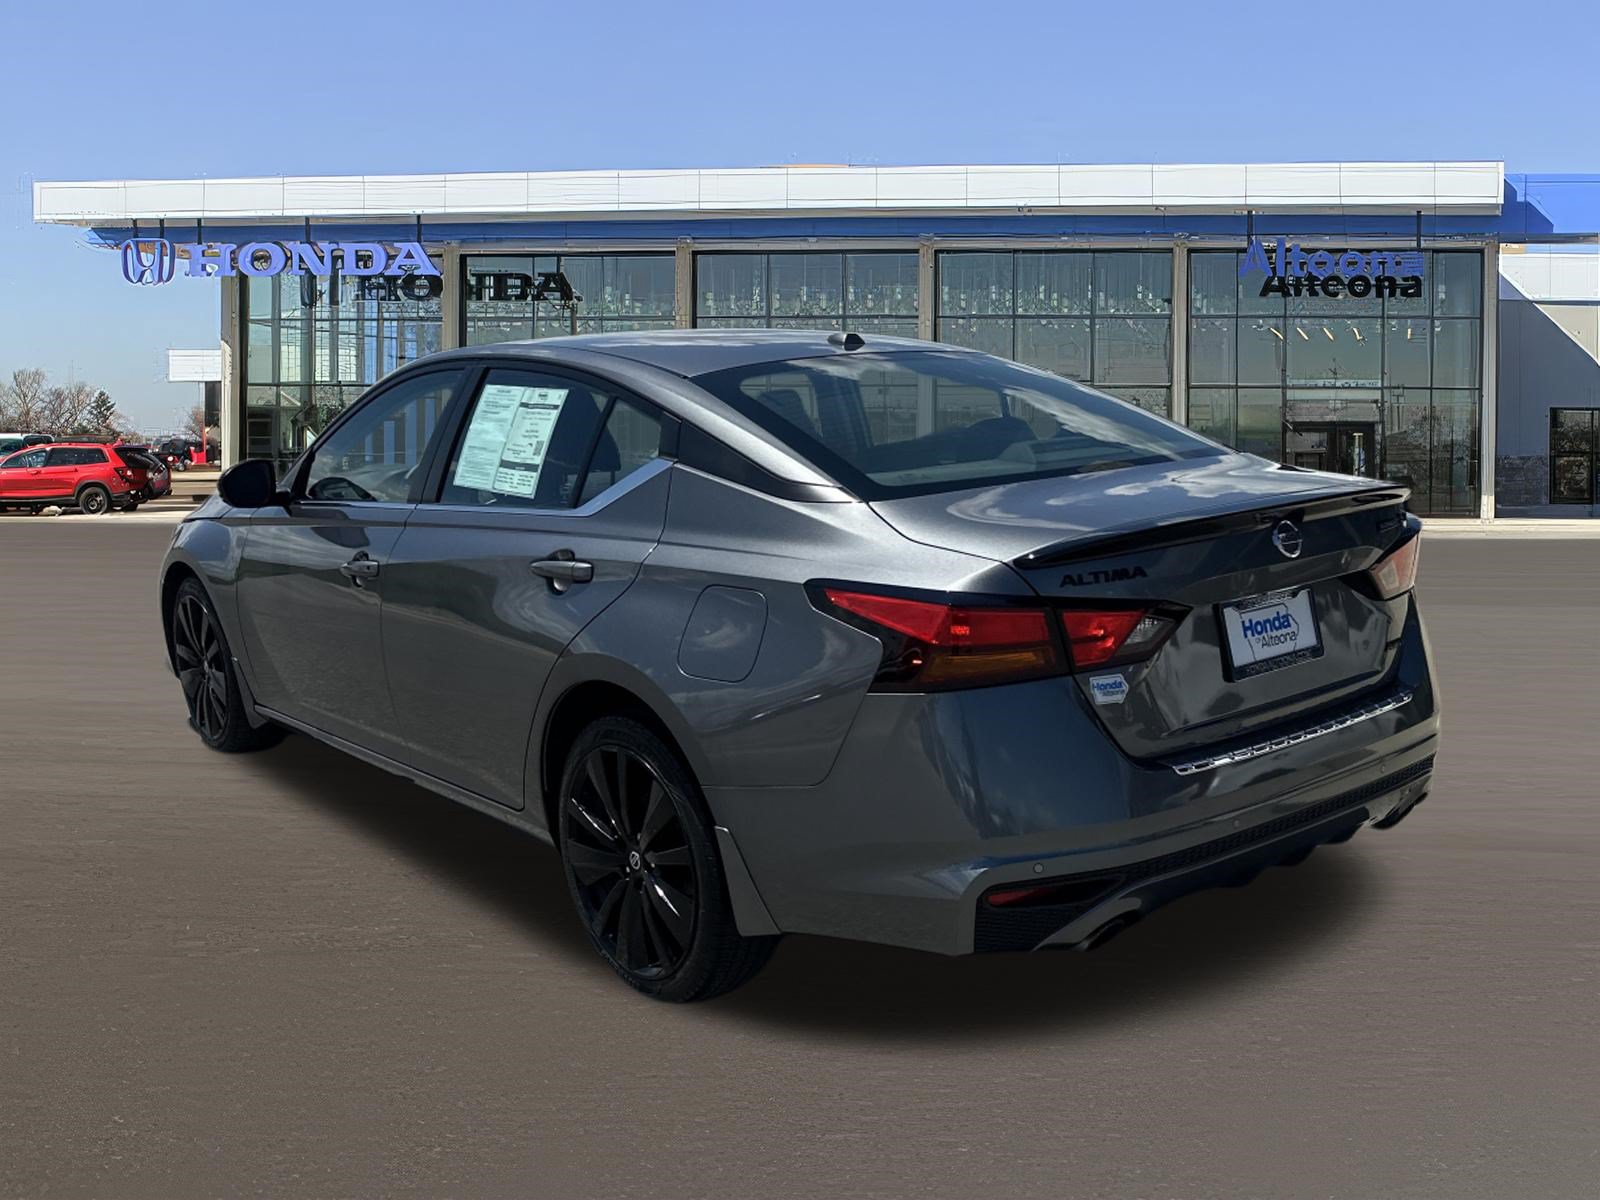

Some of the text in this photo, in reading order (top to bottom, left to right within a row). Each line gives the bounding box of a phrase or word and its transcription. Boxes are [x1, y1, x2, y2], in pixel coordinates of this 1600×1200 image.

[184, 241, 441, 276] HONDA
[1059, 566, 1148, 588] ALTIMA
[1241, 611, 1292, 639] Honda
